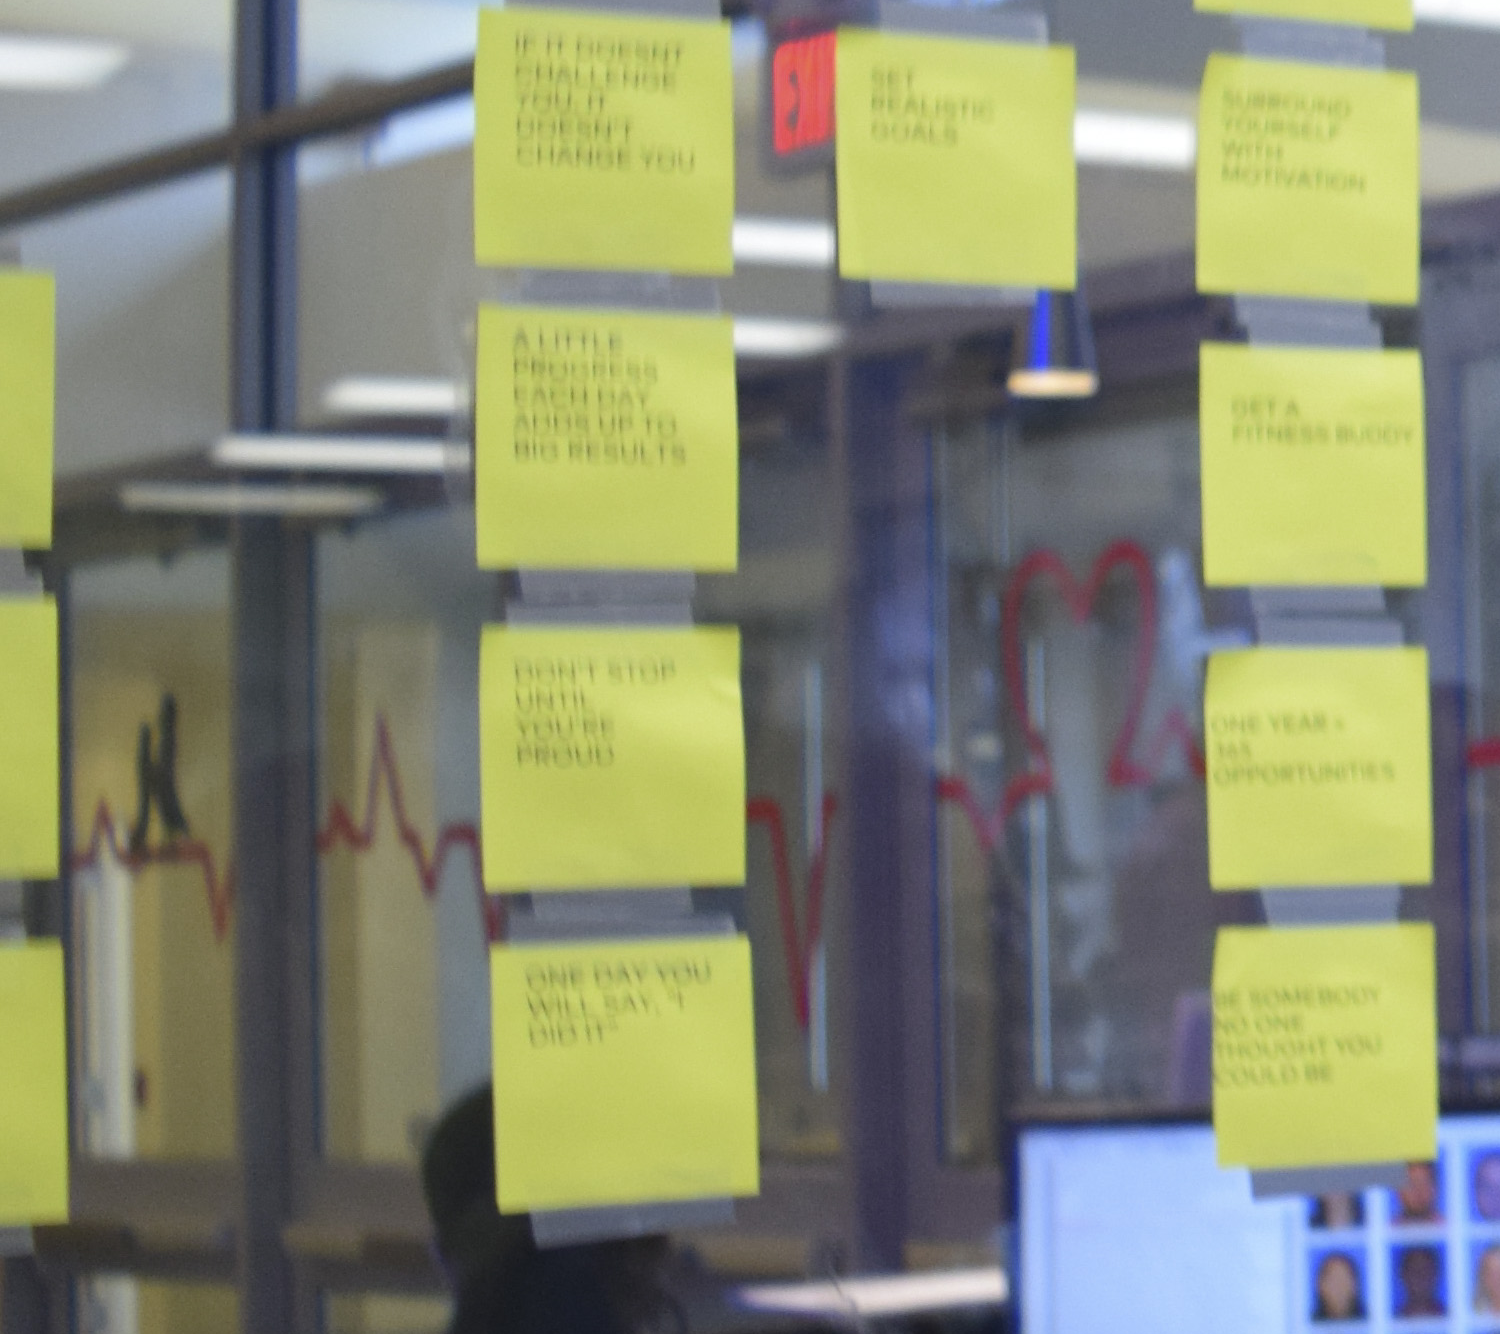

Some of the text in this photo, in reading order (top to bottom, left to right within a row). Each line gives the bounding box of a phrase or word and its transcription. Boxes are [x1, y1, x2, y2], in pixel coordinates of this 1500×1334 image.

[515, 30, 533, 52] IF
[545, 33, 564, 55] IT
[515, 58, 678, 95] CHALLENGE
[871, 66, 915, 91] SET
[586, 91, 606, 113] IT
[871, 94, 996, 124] REALISTIC
[1222, 87, 1353, 119] SURROUND
[515, 114, 633, 144] DOESN'T
[871, 123, 958, 148] GOALS
[1222, 114, 1341, 141] YOURSELF
[515, 140, 697, 175] CHANGE YOU
[1222, 139, 1284, 163] WITH
[1222, 164, 1365, 194] MOTIVATION
[513, 325, 623, 354] A LITTLE
[513, 354, 659, 383] PROGRESS
[513, 381, 651, 410] EACH DAY
[1231, 395, 1301, 420] GET A
[513, 409, 678, 439] ADDS UP TO
[1231, 423, 1411, 445] FITNESS BUDDY
[513, 435, 687, 466] BIG RESULTS
[514, 656, 677, 685] DON'T STOP
[514, 687, 587, 714] UNTIL
[515, 715, 615, 741] YOU'RE
[1211, 712, 1260, 734] ONE
[1268, 712, 1327, 734] YEAR
[515, 743, 615, 770] PROUD
[1213, 761, 1396, 787] OPPORTUNITIES
[526, 957, 712, 992] ONE DAY YOU
[526, 987, 586, 1017] WILL
[1214, 986, 1380, 1009] BE SOMEBODY
[527, 1017, 578, 1049] DID
[1214, 1013, 1305, 1034] NO ONE
[1214, 1033, 1383, 1059] THOUGHT YOU
[1214, 1062, 1334, 1086] COULD BE
